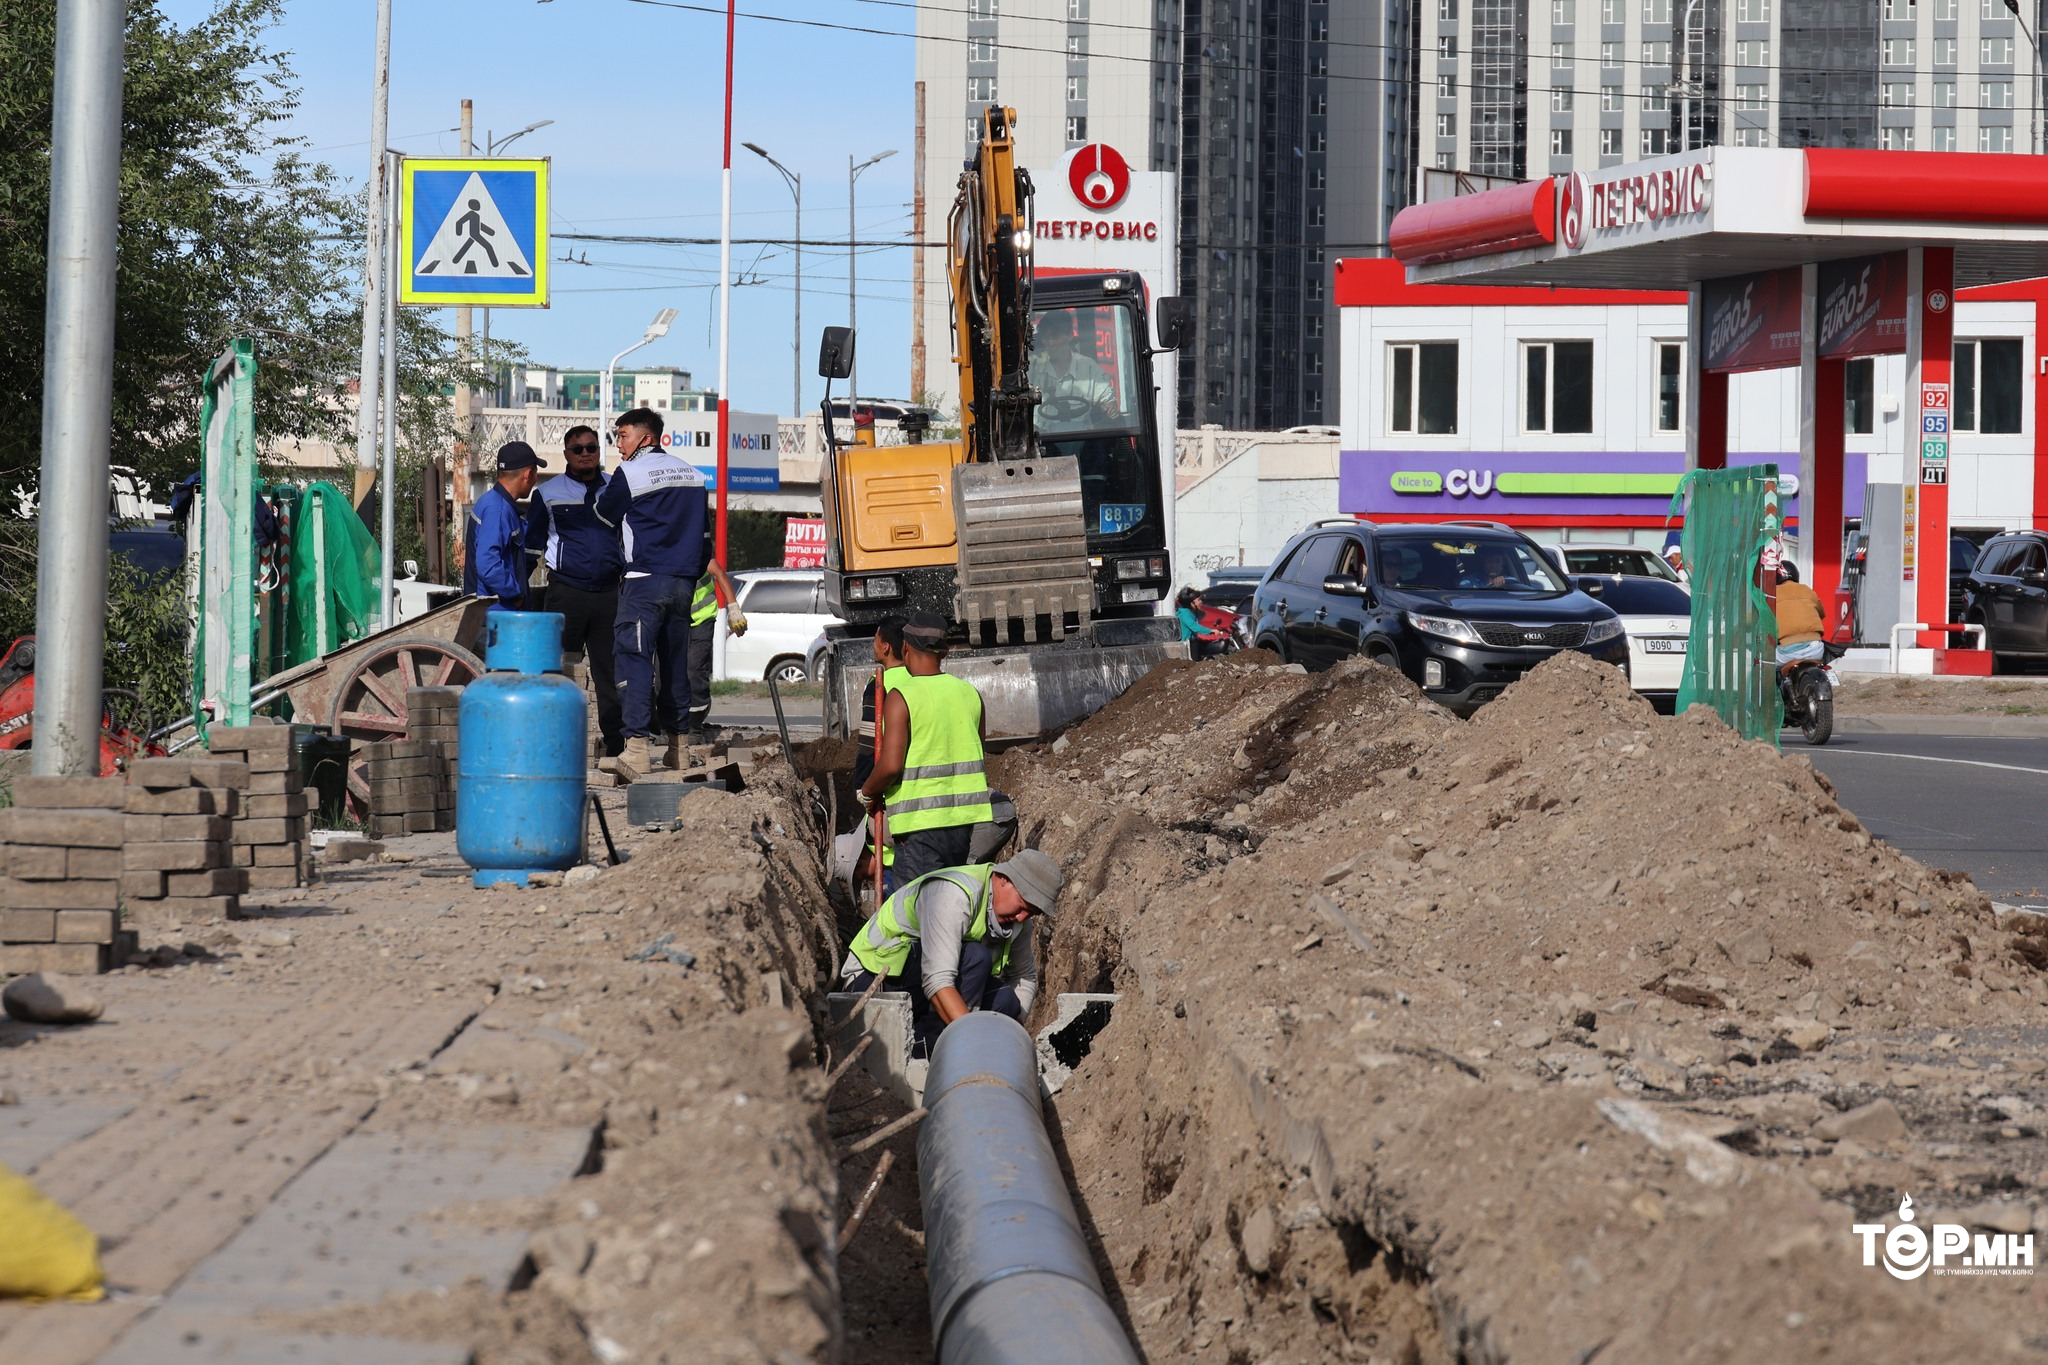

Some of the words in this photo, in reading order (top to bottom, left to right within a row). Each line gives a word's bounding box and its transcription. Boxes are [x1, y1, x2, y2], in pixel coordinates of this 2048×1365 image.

[1593, 163, 1709, 229] ПЕТРОВИС
[1036, 220, 1157, 240] ПЕТРОВИС
[1926, 392, 1945, 407] 92
[1926, 418, 1945, 432] 95
[661, 431, 692, 447] obil
[732, 433, 760, 450] Mobil
[1925, 443, 1944, 457] 98
[1398, 477, 1420, 487] Nice
[1423, 478, 1433, 487] to
[1446, 469, 1492, 495] CU
[1924, 468, 1944, 483] ДТ
[1650, 641, 1672, 650] 9090
